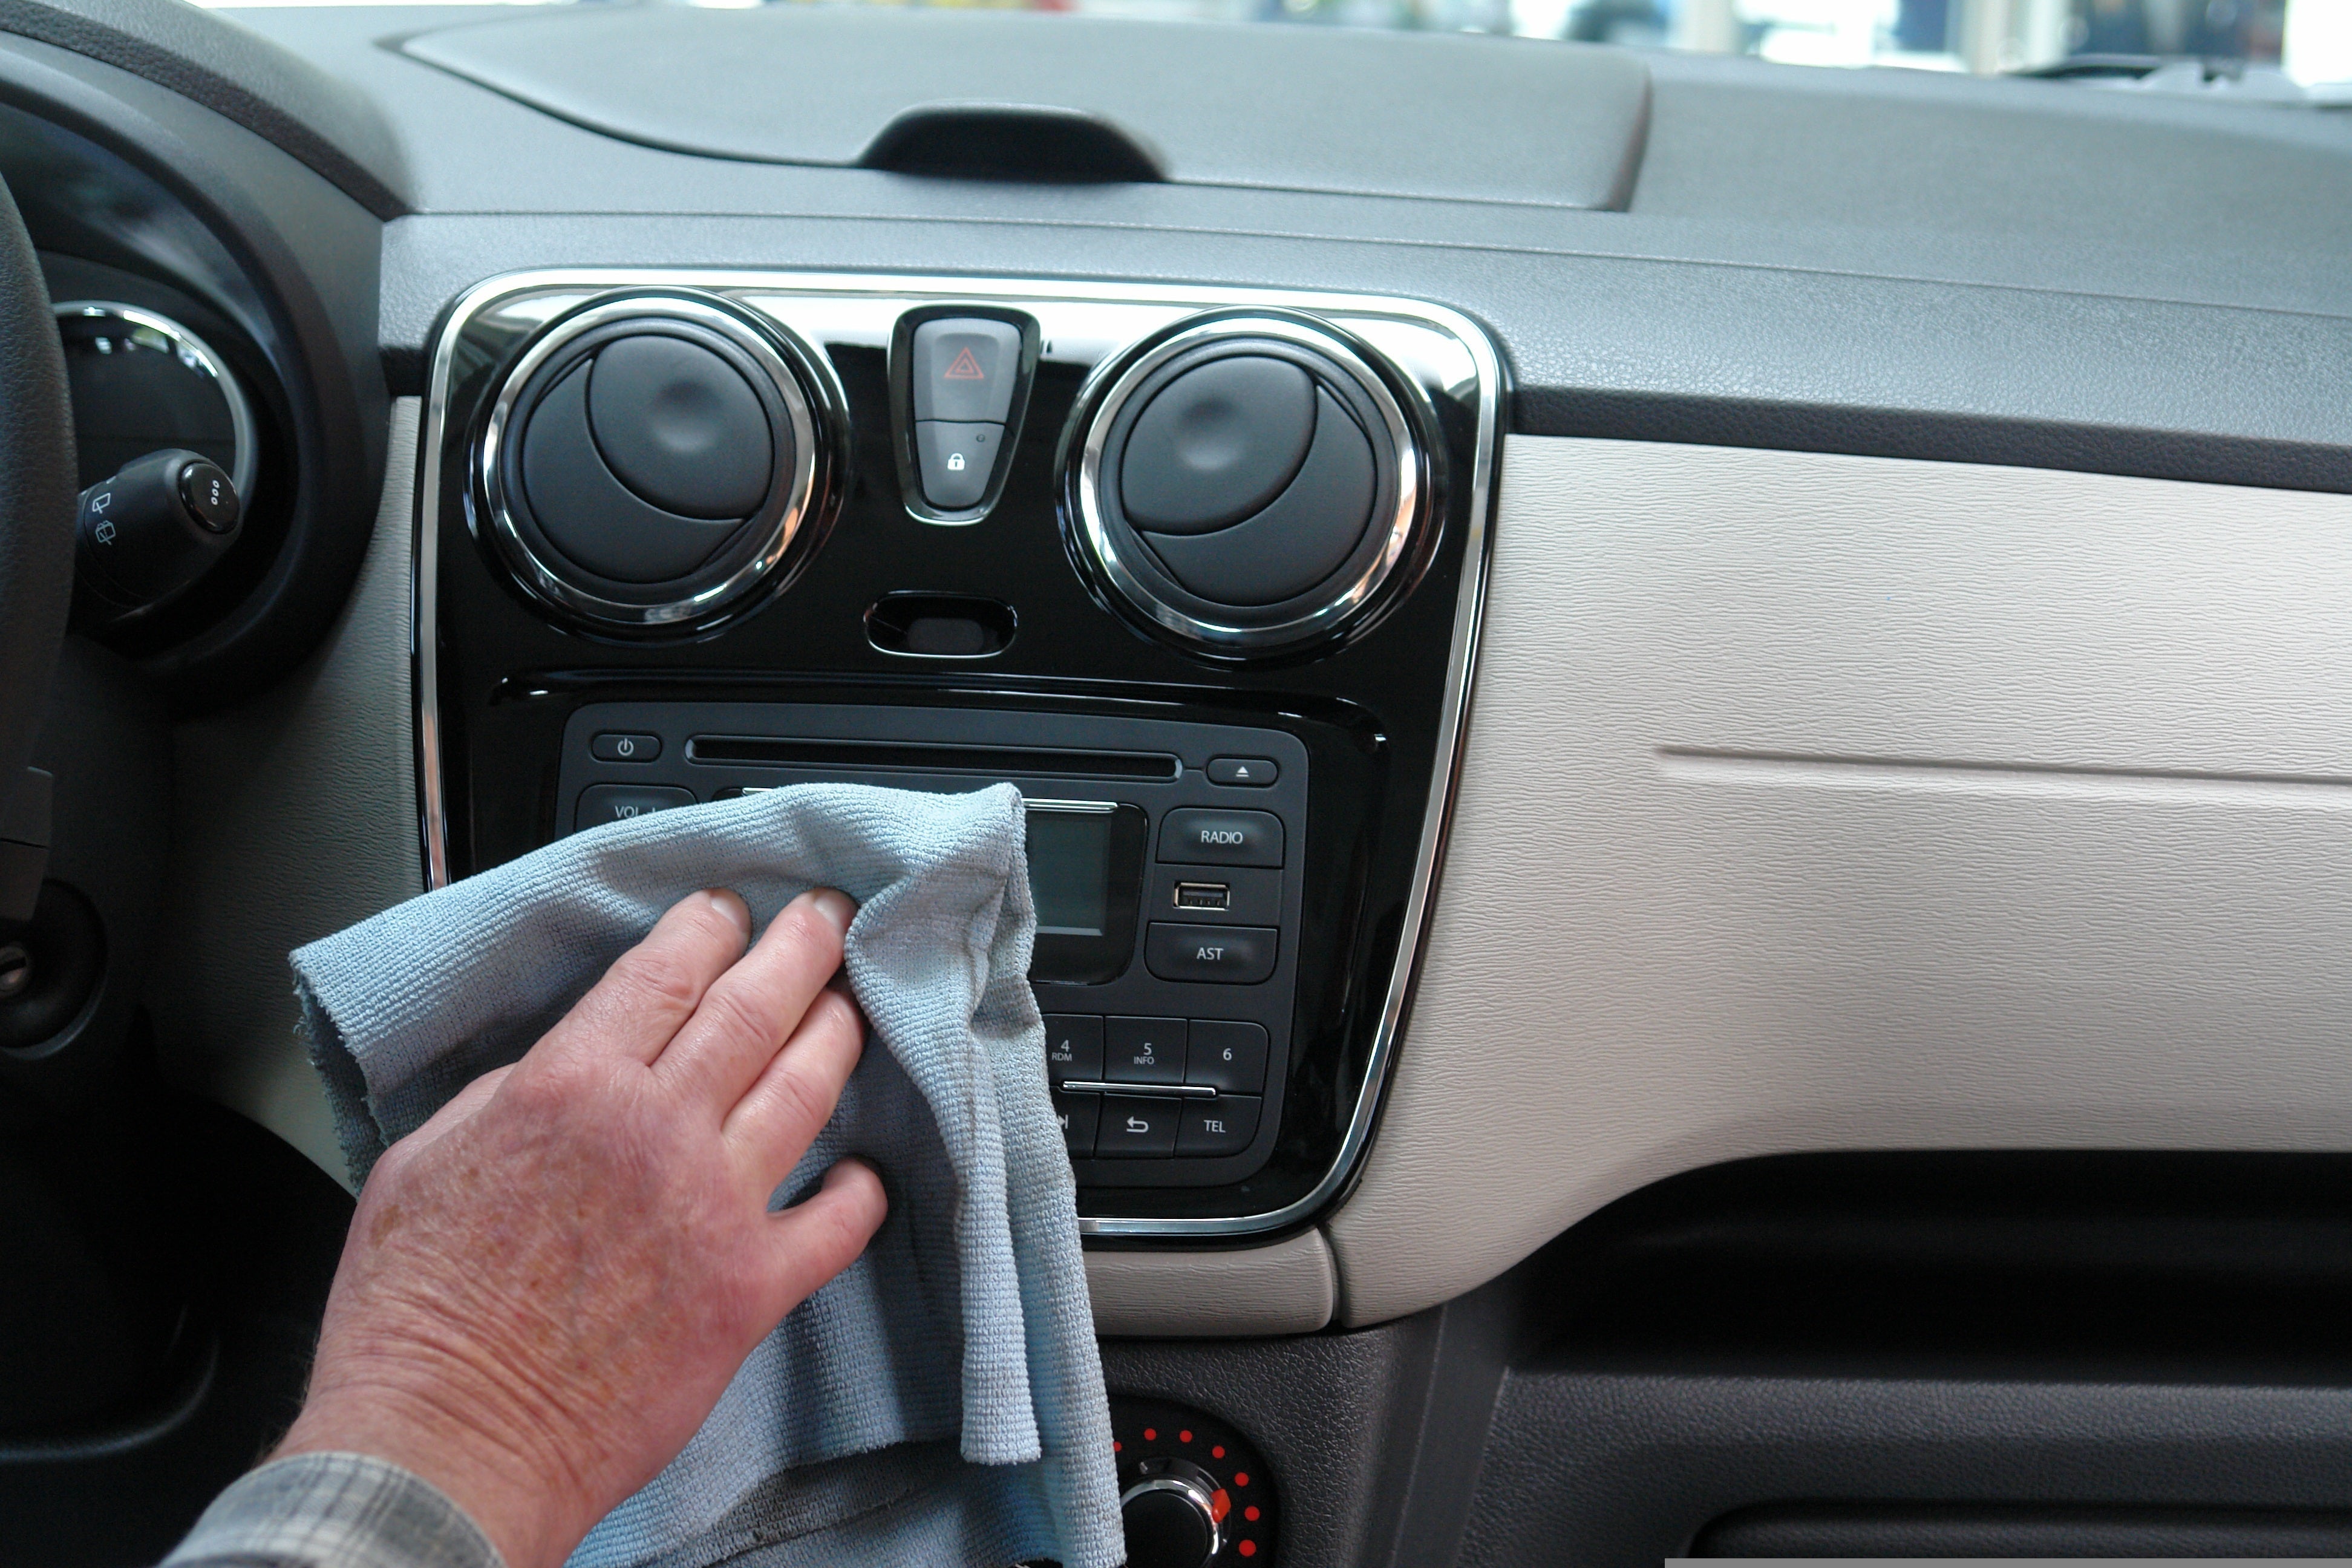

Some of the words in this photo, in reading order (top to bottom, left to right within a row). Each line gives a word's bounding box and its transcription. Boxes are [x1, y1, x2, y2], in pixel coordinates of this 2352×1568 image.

[1201, 830, 1243, 844] RADIO
[1196, 947, 1224, 961] AST
[1060, 1039, 1070, 1052] 4
[1143, 1042, 1152, 1056] 5
[1051, 1052, 1072, 1062] RDM
[1134, 1056, 1154, 1065] INFO
[1223, 1048, 1232, 1061] 6
[1203, 1119, 1226, 1133] TEL
